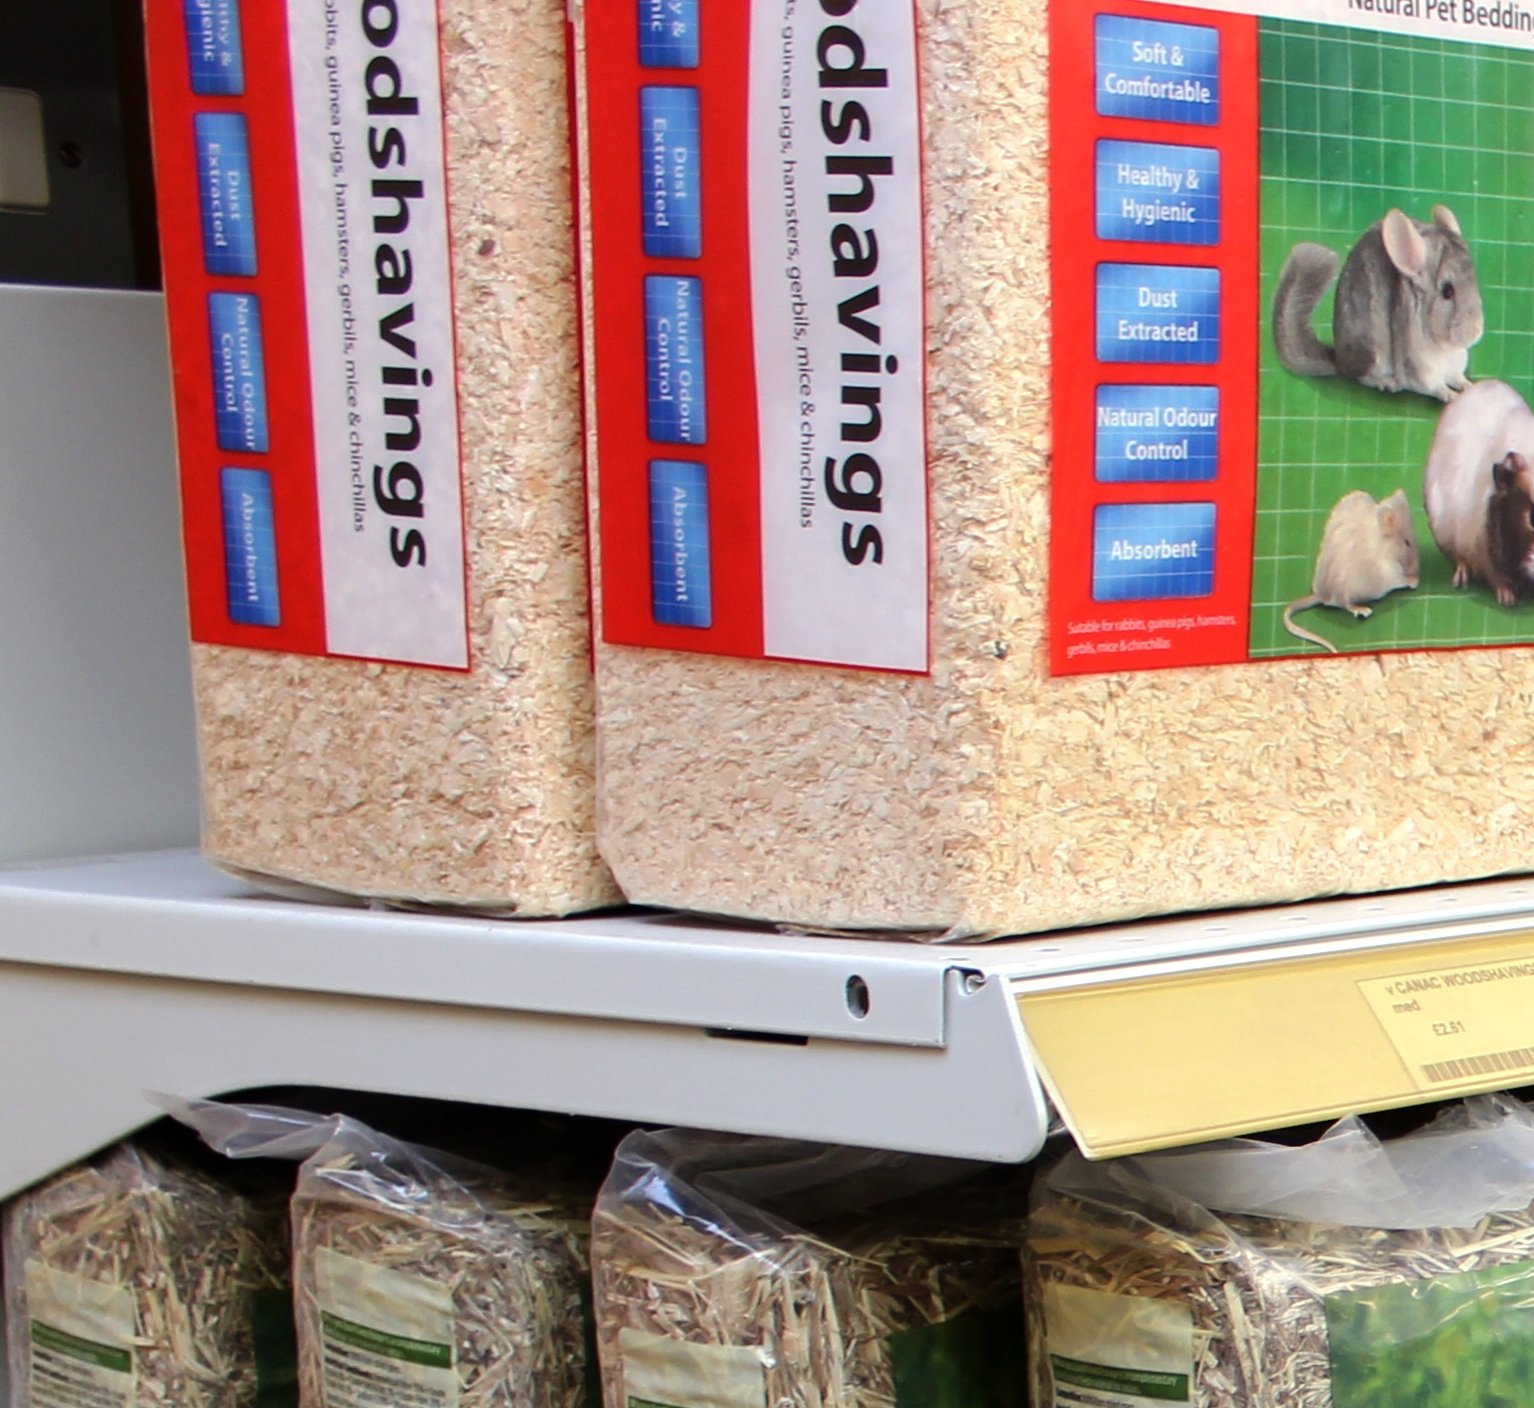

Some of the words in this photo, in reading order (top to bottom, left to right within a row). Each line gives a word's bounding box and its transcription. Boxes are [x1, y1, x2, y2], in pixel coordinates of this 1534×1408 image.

[1426, 0, 1458, 23] Pet
[781, 27, 796, 99] guinea
[1132, 40, 1168, 66] Soft
[1171, 45, 1184, 67] &
[325, 56, 343, 127] guinea
[1104, 73, 1212, 104] Comfortable
[329, 132, 345, 178] pigs,
[779, 105, 796, 154] pigs,
[208, 143, 228, 247] Extracted
[227, 171, 241, 220] Dust
[653, 118, 670, 228] Extracted
[673, 147, 688, 199] Dust
[1117, 163, 1183, 194] Healthy
[1187, 168, 1200, 190] &
[335, 184, 350, 279] hamsters,
[783, 160, 800, 261] hamsters,
[1122, 198, 1196, 226] Hygienic
[338, 284, 357, 354] gerbils,
[676, 280, 691, 364] Natural
[786, 266, 811, 343] gerbils,
[1138, 286, 1178, 309] Dust
[236, 298, 252, 377] Natural
[1118, 320, 1199, 343] Extracted
[221, 333, 238, 412] Control
[346, 360, 360, 407] mice
[658, 318, 673, 401] Control
[796, 346, 812, 397] mice
[349, 412, 361, 426] &
[678, 369, 691, 441] Odour
[801, 401, 815, 416] &
[1097, 407, 1160, 428] Natural
[1164, 407, 1217, 428] Odour
[801, 421, 816, 528] chinchillas
[1125, 439, 1189, 461] Control
[351, 432, 367, 533] chinchillas
[242, 492, 258, 602] Absorbent
[673, 486, 689, 602] Absorbent
[1111, 540, 1198, 561] Absorbent
